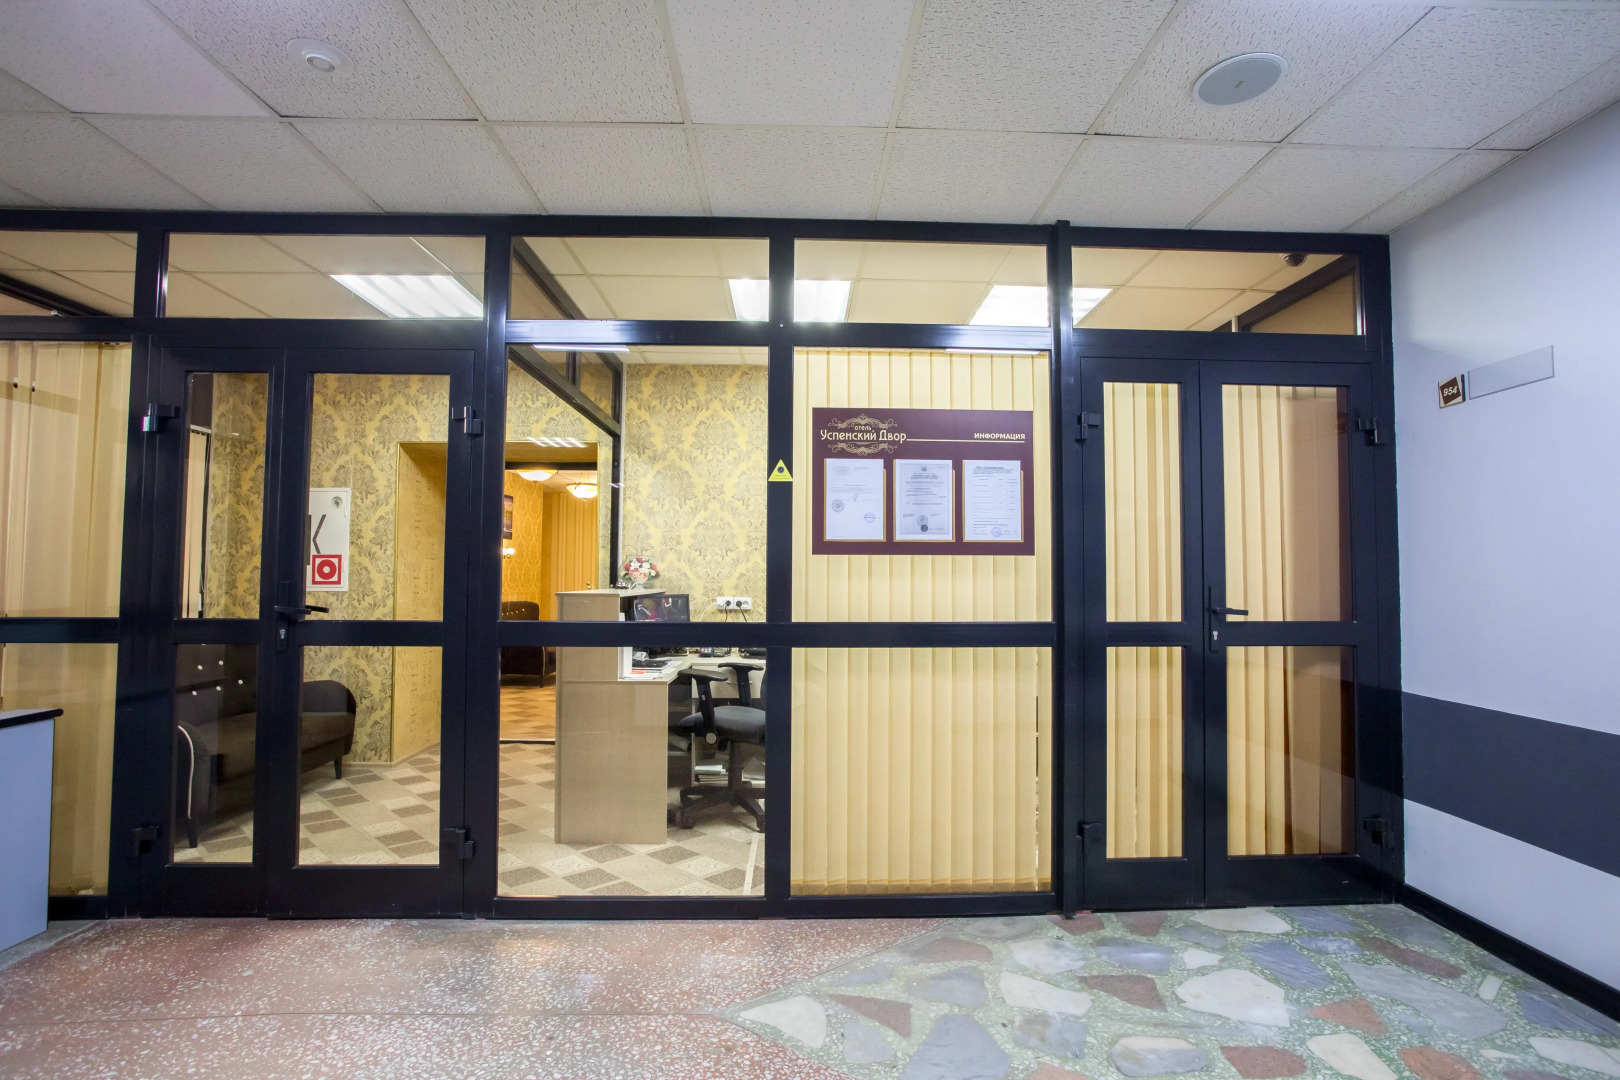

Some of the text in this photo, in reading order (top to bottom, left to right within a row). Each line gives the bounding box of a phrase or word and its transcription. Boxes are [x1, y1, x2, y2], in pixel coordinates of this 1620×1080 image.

[1443, 386, 1458, 396] 954
[820, 429, 907, 444] Успенский Двор
[974, 432, 1026, 441] ИНФОРМАЦИЯ
